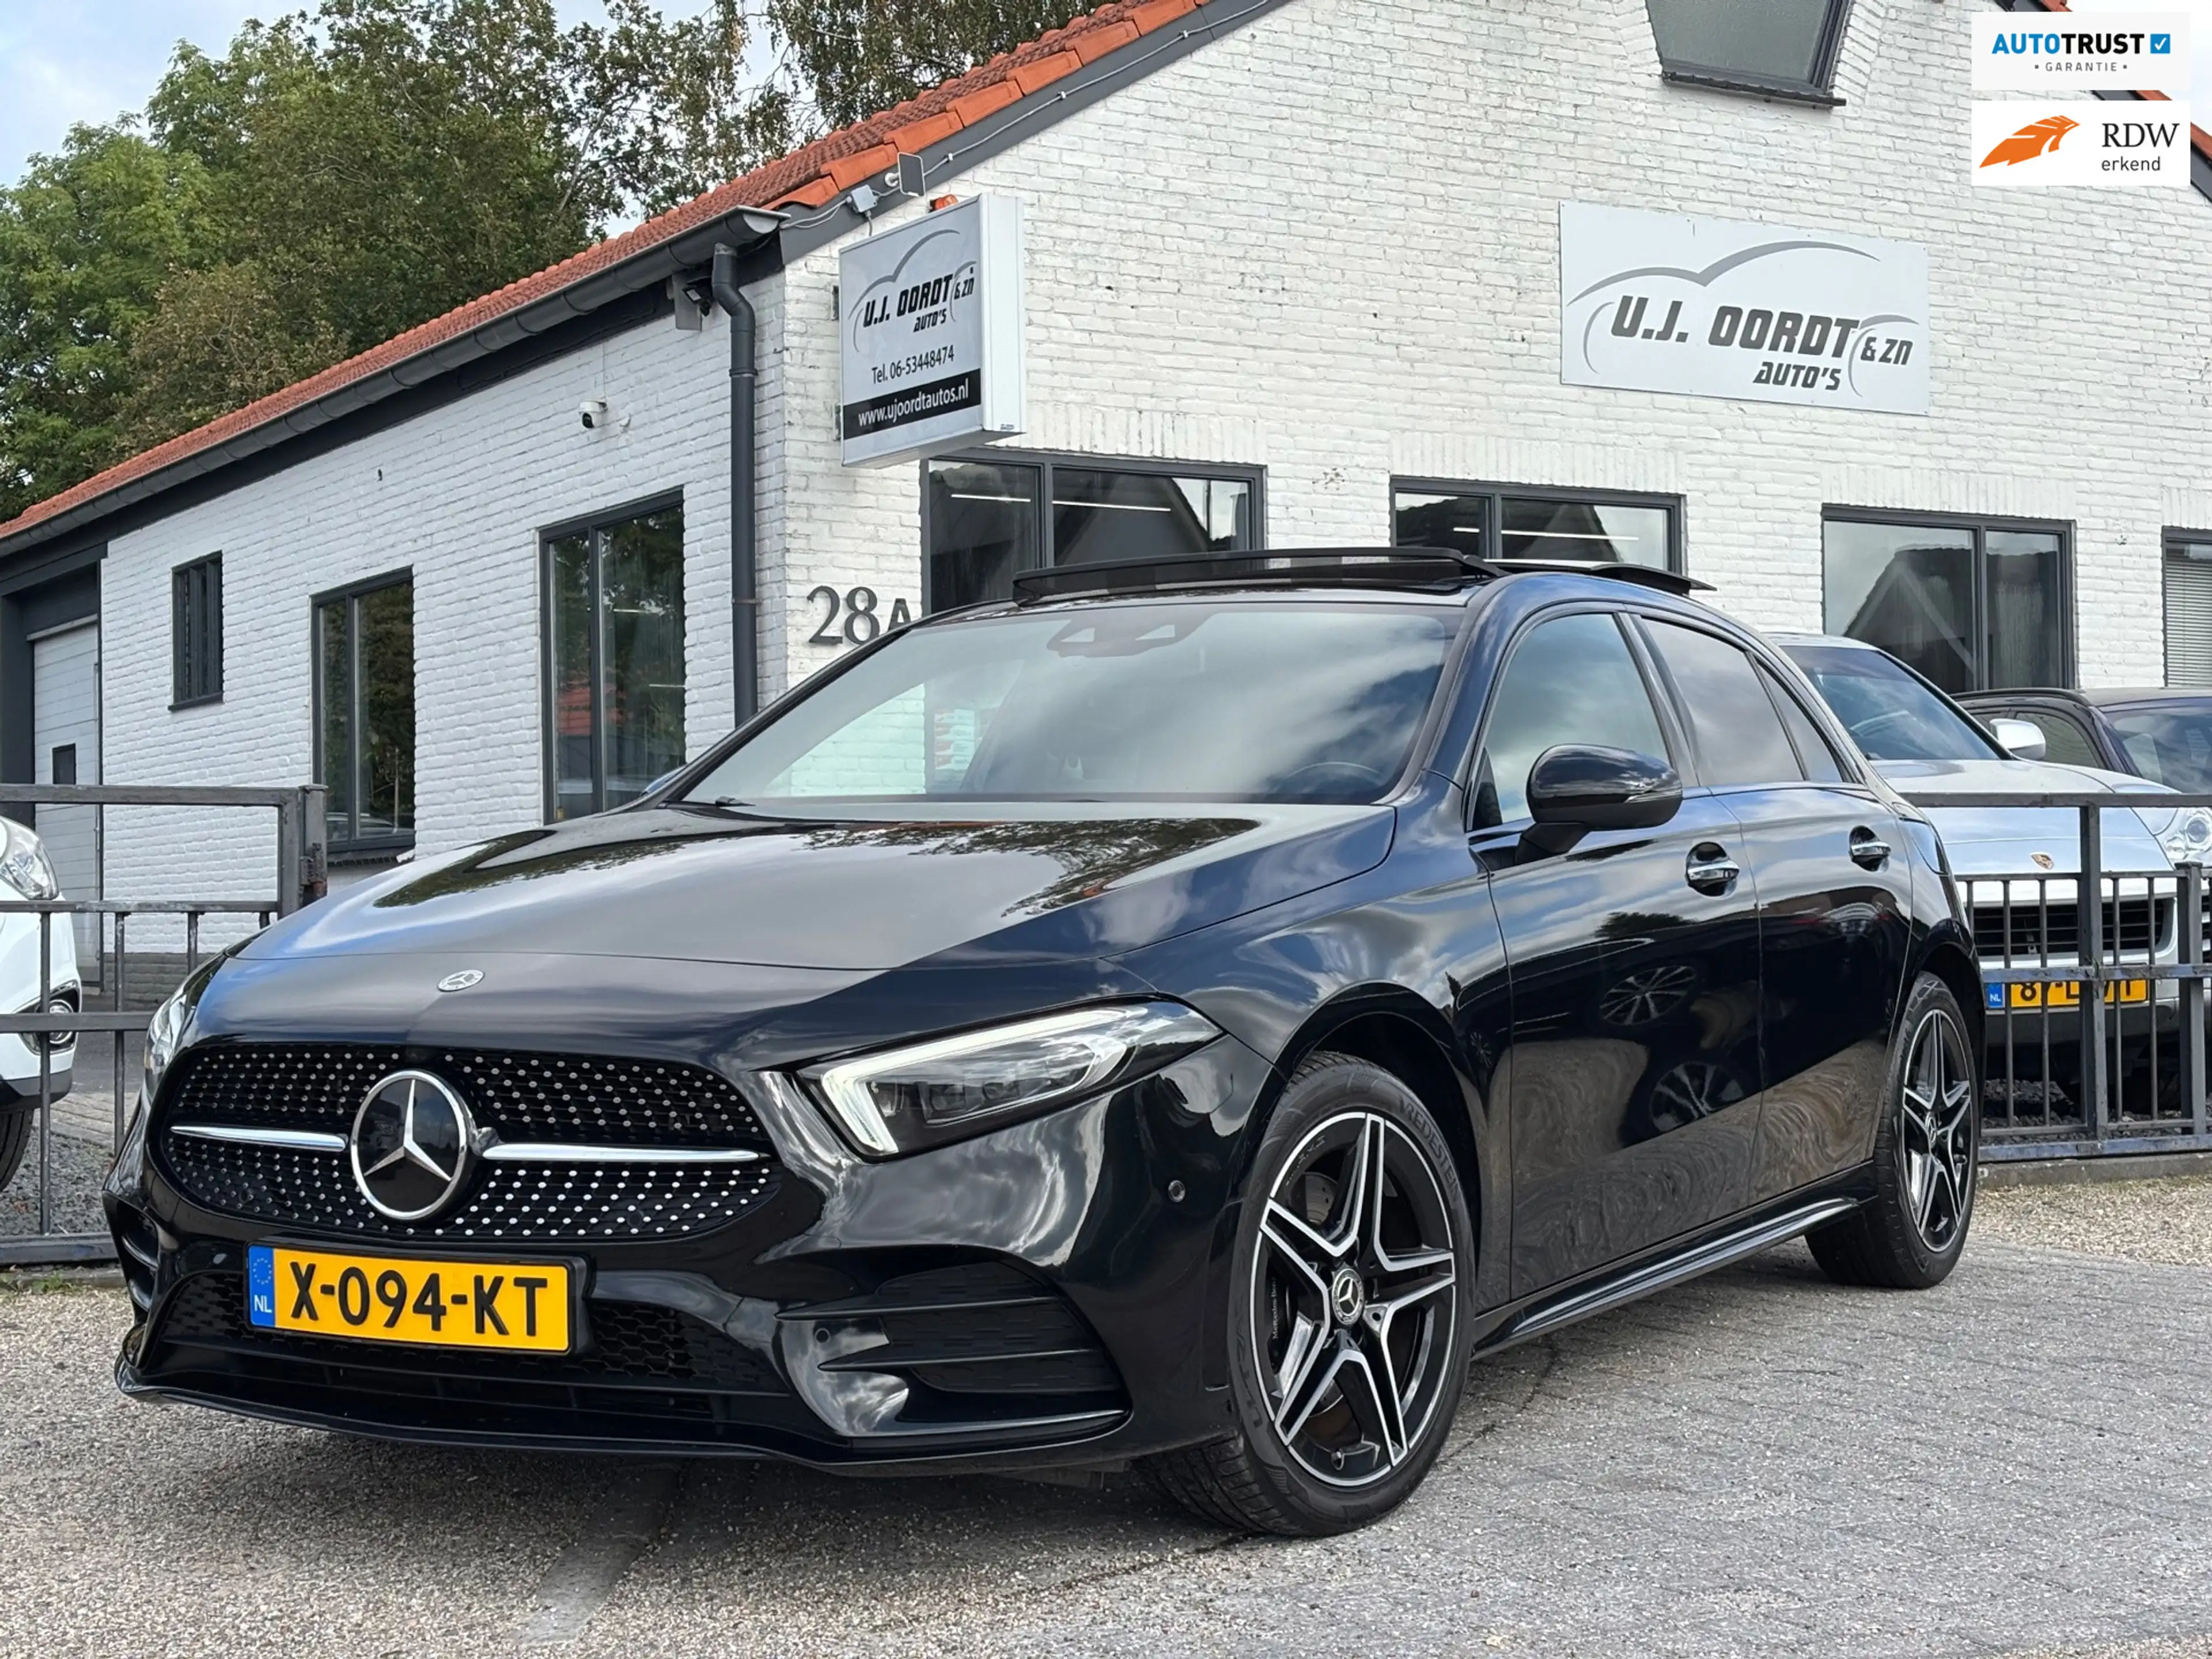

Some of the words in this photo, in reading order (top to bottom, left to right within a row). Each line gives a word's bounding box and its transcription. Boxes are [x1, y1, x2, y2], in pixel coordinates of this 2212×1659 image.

[863, 295, 891, 328] U.J.
[896, 273, 953, 317] OORDT
[913, 308, 946, 333] AUTO'S
[1611, 295, 1689, 343] U.J.
[1708, 305, 1860, 358] OORDT
[871, 363, 888, 384] Tel.
[890, 344, 955, 380] 06-53448474
[1752, 361, 1842, 391] AUTO'S
[858, 377, 969, 427] www.ujoordtautos.nl
[806, 585, 911, 645] 28A
[1990, 993, 2001, 1002] NL
[254, 1295, 272, 1313] NL
[290, 1261, 548, 1337] X-094-KT
